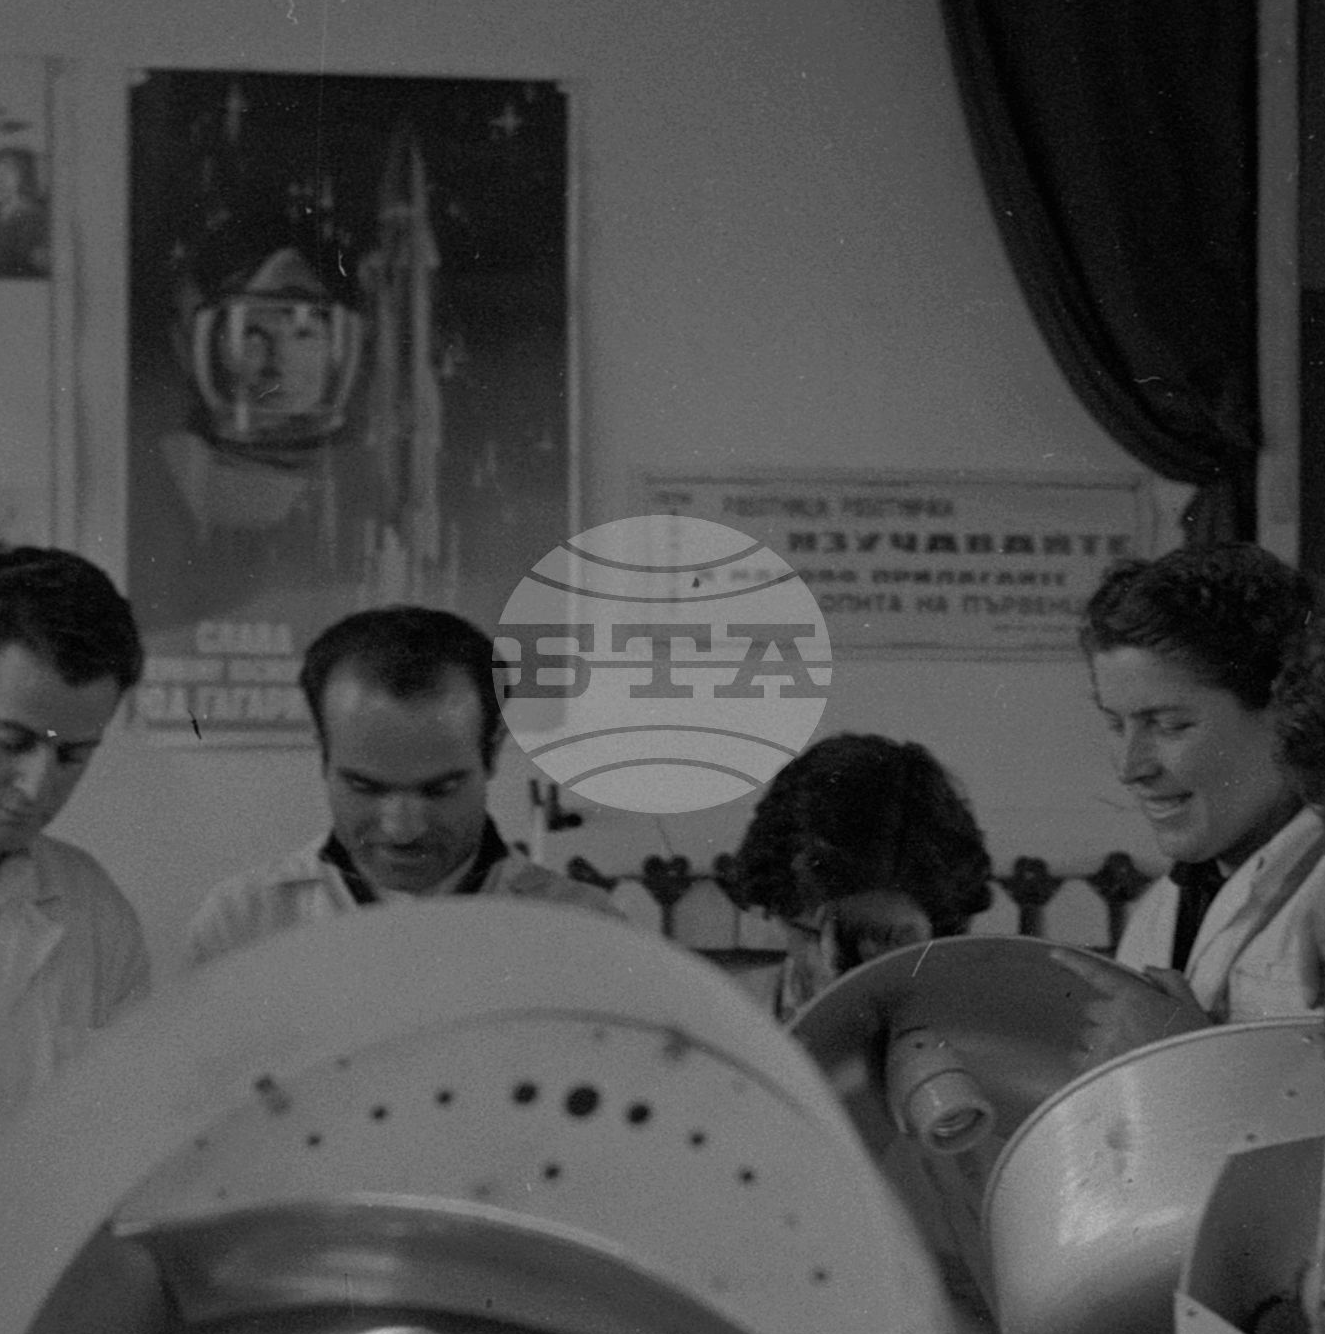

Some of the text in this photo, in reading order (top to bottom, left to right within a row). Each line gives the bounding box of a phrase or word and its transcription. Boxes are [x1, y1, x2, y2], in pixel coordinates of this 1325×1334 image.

[787, 530, 1131, 556] ИЗУЧАВАЙТЕ
[870, 568, 1067, 587] ПРИЛАГАЙТЕ
[915, 594, 949, 615] НА
[962, 594, 1086, 617] ПЪРВЕНЦ
